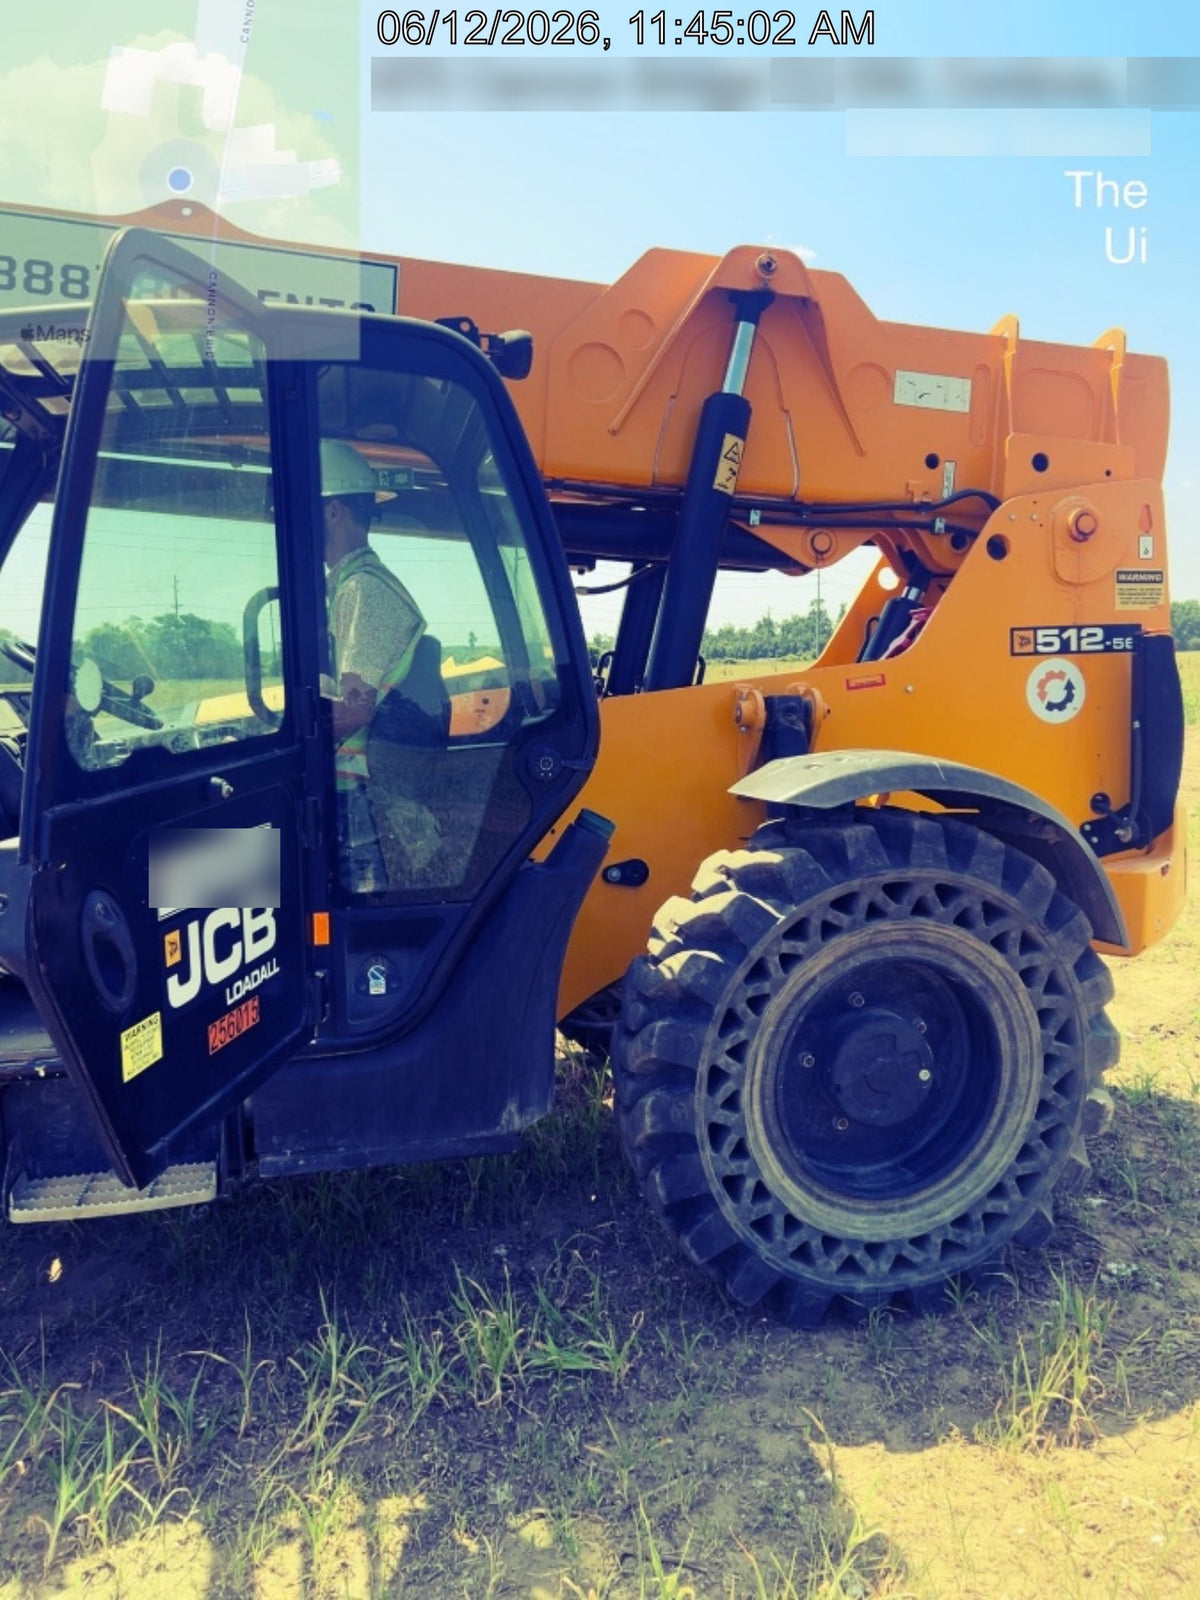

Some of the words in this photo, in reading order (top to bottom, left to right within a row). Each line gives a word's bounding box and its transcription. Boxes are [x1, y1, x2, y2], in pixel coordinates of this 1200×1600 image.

[166, 907, 277, 1009] JCB
[225, 957, 280, 1006] LOADALL
[210, 999, 259, 1051] 256015
